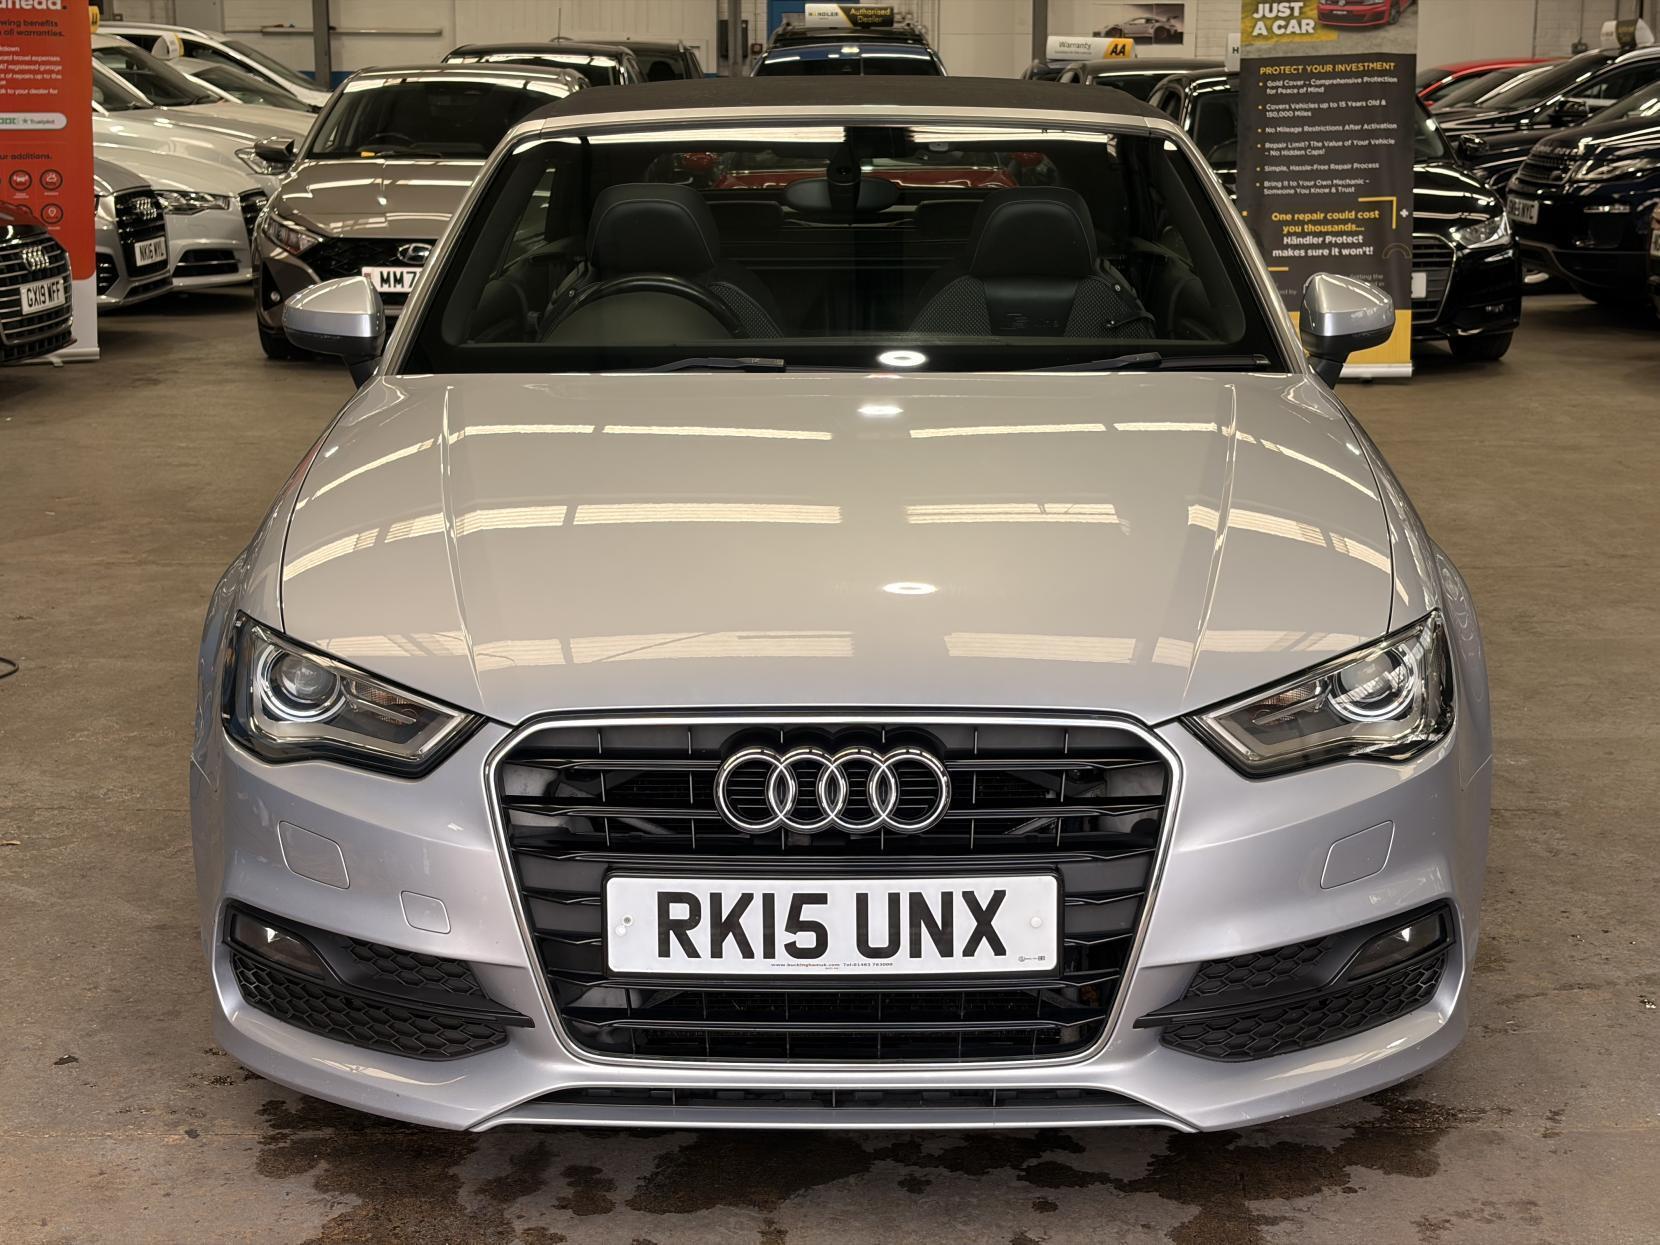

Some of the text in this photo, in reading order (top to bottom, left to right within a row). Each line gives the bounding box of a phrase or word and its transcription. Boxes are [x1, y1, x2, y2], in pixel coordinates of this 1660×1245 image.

[849, 8, 891, 16] Authorised
[1252, 2, 1304, 19] JUST
[23, 19, 58, 27] benefits
[1252, 19, 1315, 36] A CAR
[1058, 41, 1092, 50] Warranty
[1110, 43, 1126, 56] AA
[1259, 62, 1396, 75] PROTECT YOUR INVESTMENT
[1284, 79, 1304, 87] Cover
[1310, 77, 1362, 86] Comprehensive
[1363, 76, 1398, 84] Protection
[1290, 102, 1318, 110] Vehicles
[1276, 126, 1302, 134] Mileage
[1303, 125, 1343, 133] Restrictions
[1344, 123, 1361, 131] After
[1362, 122, 1397, 130] Activation
[11, 152, 52, 160] additions.
[1306, 148, 1325, 156] Caps!
[1264, 165, 1289, 173] Simple,
[1264, 180, 1282, 188] Bring
[1271, 210, 1380, 221] One repair could cost
[1282, 223, 1365, 234] you thousands...
[1283, 234, 1364, 245] Händler Protect
[1272, 246, 1374, 257] makes sure it won't!
[657, 889, 1007, 960] RK15 UNX
